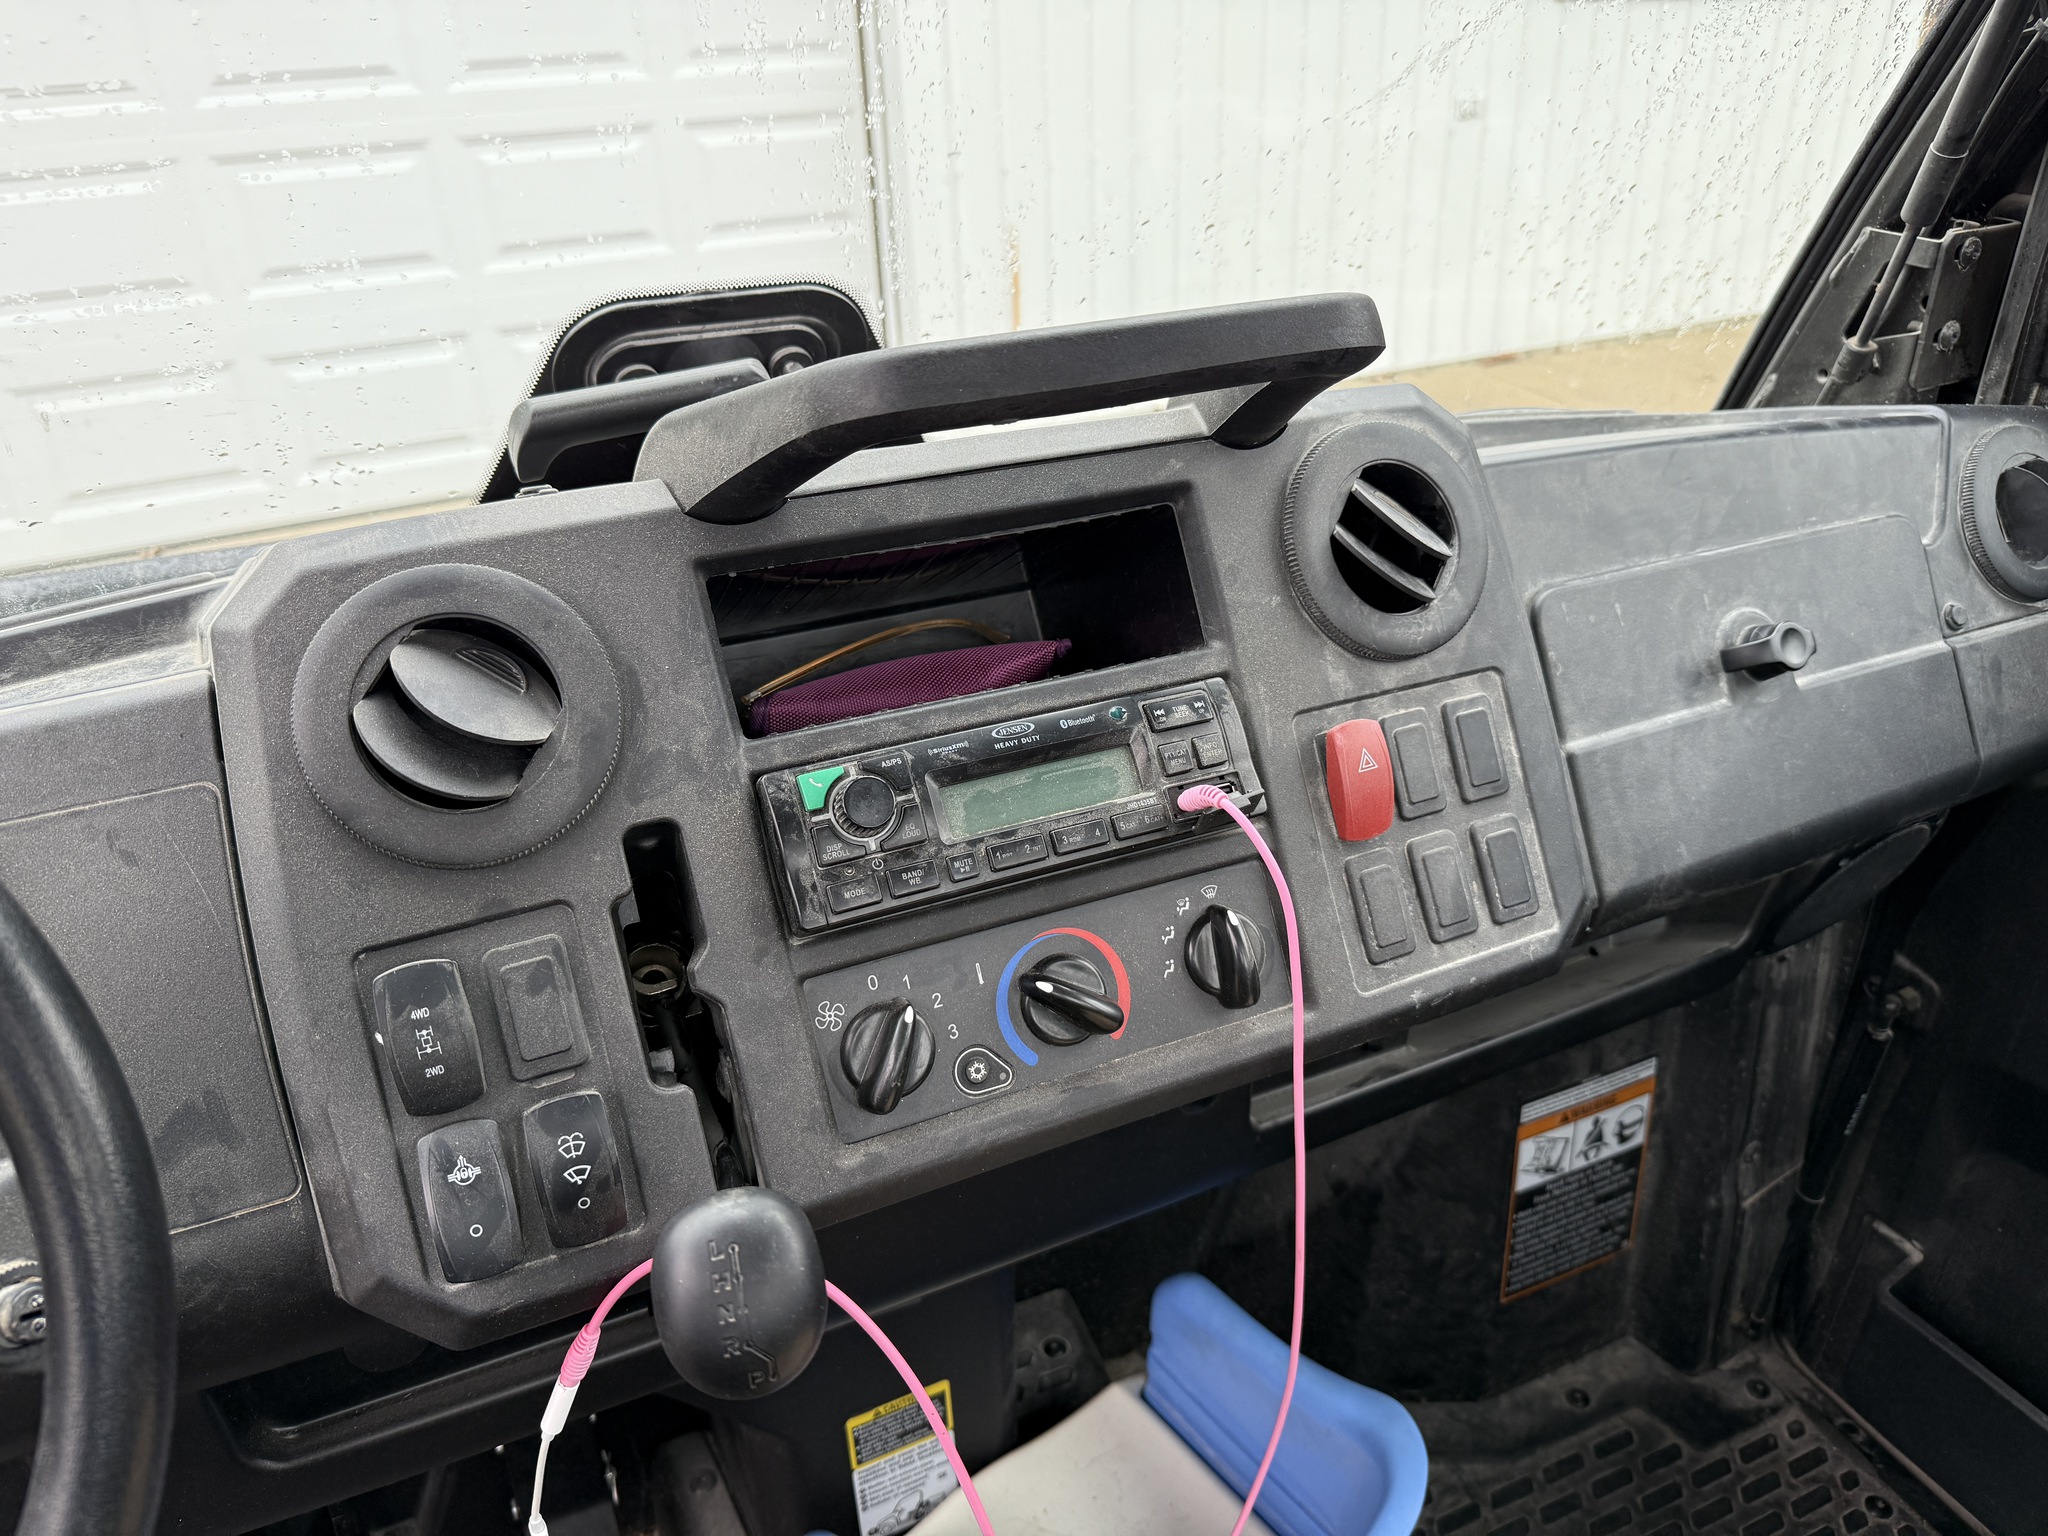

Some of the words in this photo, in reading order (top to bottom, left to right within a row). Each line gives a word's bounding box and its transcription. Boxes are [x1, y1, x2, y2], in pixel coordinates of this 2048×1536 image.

[998, 724, 1028, 737] JENSEN
[994, 739, 1019, 750] HEAVY
[1020, 734, 1041, 745] DUTY
[881, 757, 903, 768] AS/PS
[1170, 757, 1187, 766] MENU
[904, 823, 916, 831] EQ
[1095, 828, 1101, 837] 4
[902, 829, 922, 839] LOUD
[1062, 835, 1068, 845] 3
[826, 842, 843, 853] DISP
[1025, 844, 1031, 854] 2
[822, 848, 851, 861] SCROLL
[953, 857, 974, 868] MUTE
[908, 877, 922, 886] WB
[843, 887, 866, 899] MODE
[867, 974, 879, 991] 0
[902, 974, 911, 990] 1
[931, 992, 944, 1009] 2
[410, 1006, 430, 1020] 4WD
[947, 1023, 959, 1039] 3
[425, 1064, 445, 1078] 2WD
[708, 1240, 726, 1262] L
[711, 1271, 732, 1293] H
[716, 1303, 737, 1325] N
[721, 1336, 742, 1358] R
[747, 1371, 766, 1389] P
